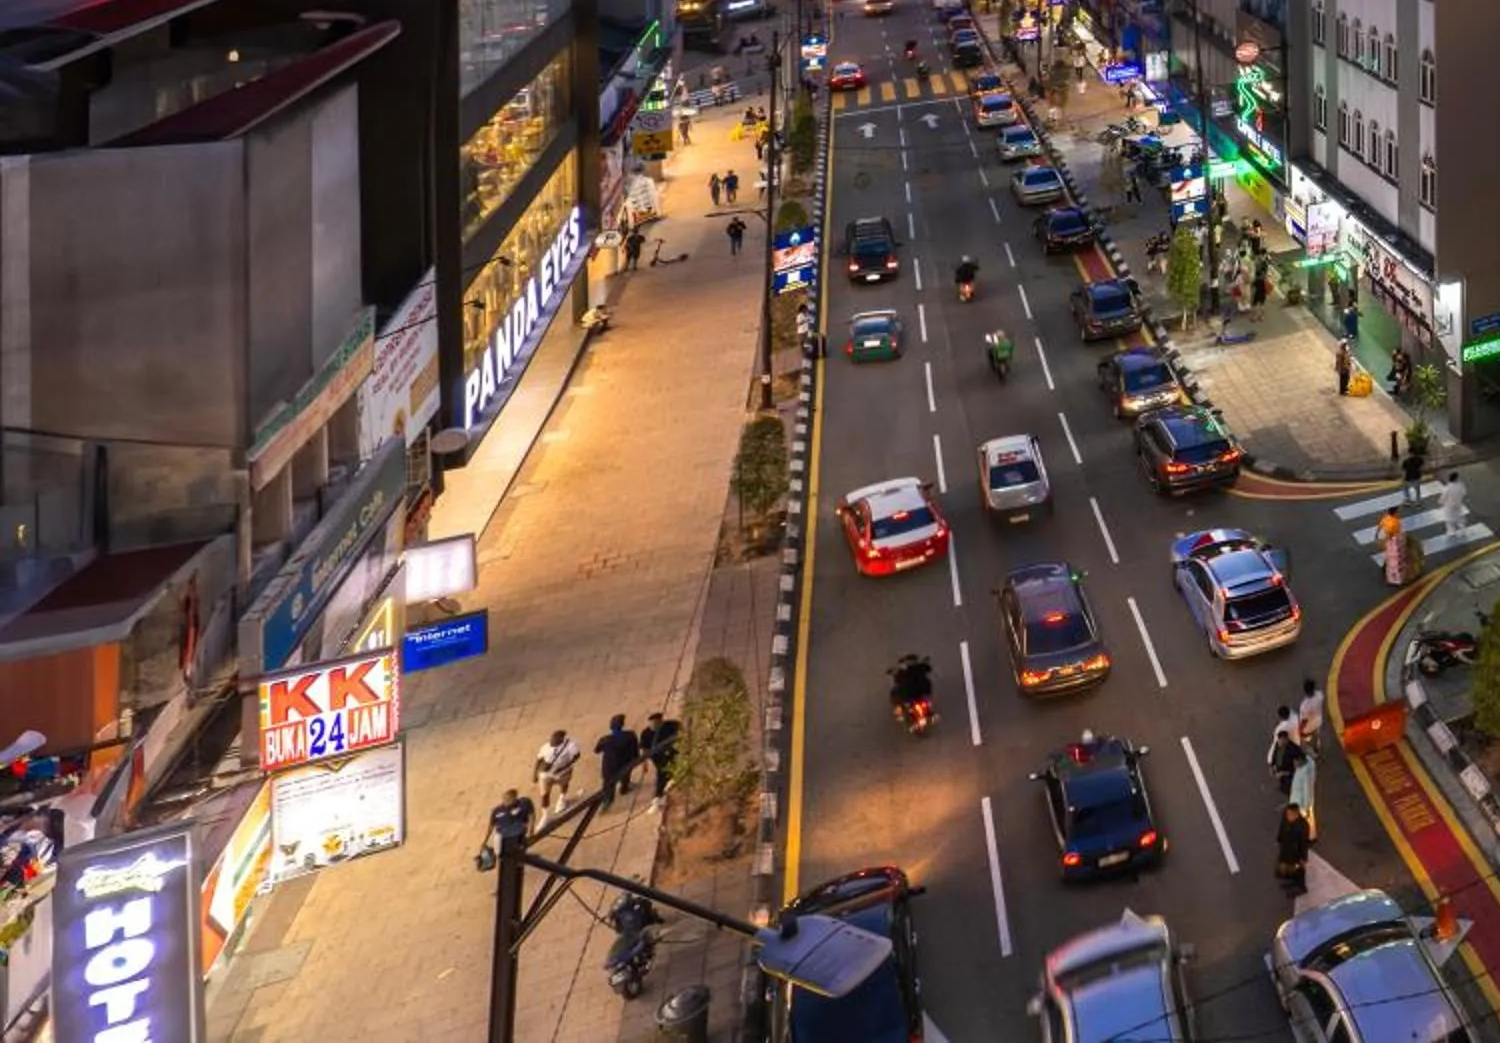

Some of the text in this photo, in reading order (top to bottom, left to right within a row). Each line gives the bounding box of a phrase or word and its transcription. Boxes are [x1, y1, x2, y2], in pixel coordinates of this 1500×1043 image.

[464, 206, 580, 431] PANDA EYES
[269, 658, 381, 726] KK
[265, 703, 389, 766] BUKA 24 JAM
